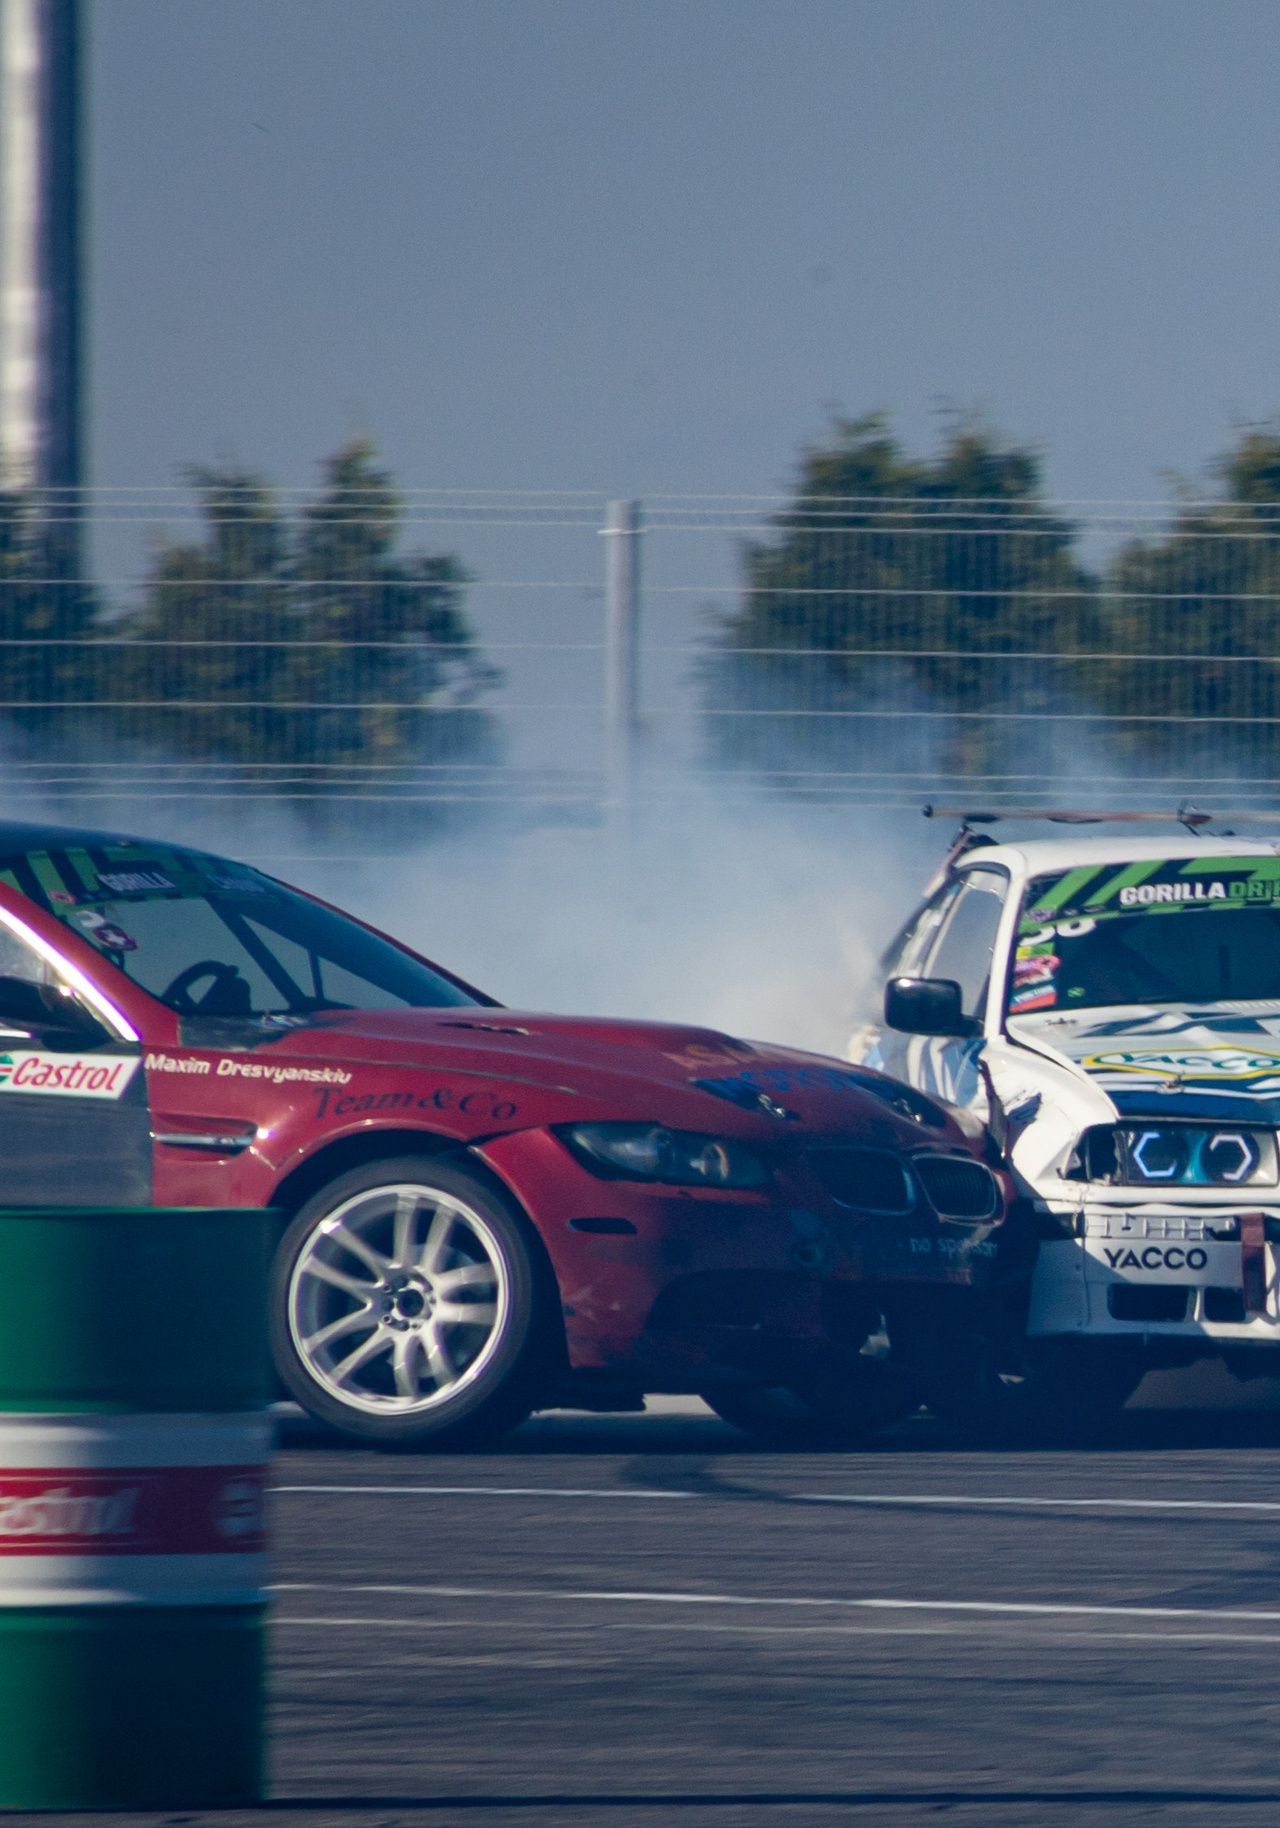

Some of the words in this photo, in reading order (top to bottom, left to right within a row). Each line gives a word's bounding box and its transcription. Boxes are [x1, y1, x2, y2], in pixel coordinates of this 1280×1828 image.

[1120, 881, 1226, 906] GORILLA
[12, 1057, 124, 1091] Castrol
[144, 1053, 211, 1075] Maxim
[1103, 1246, 1208, 1270] YACCO
